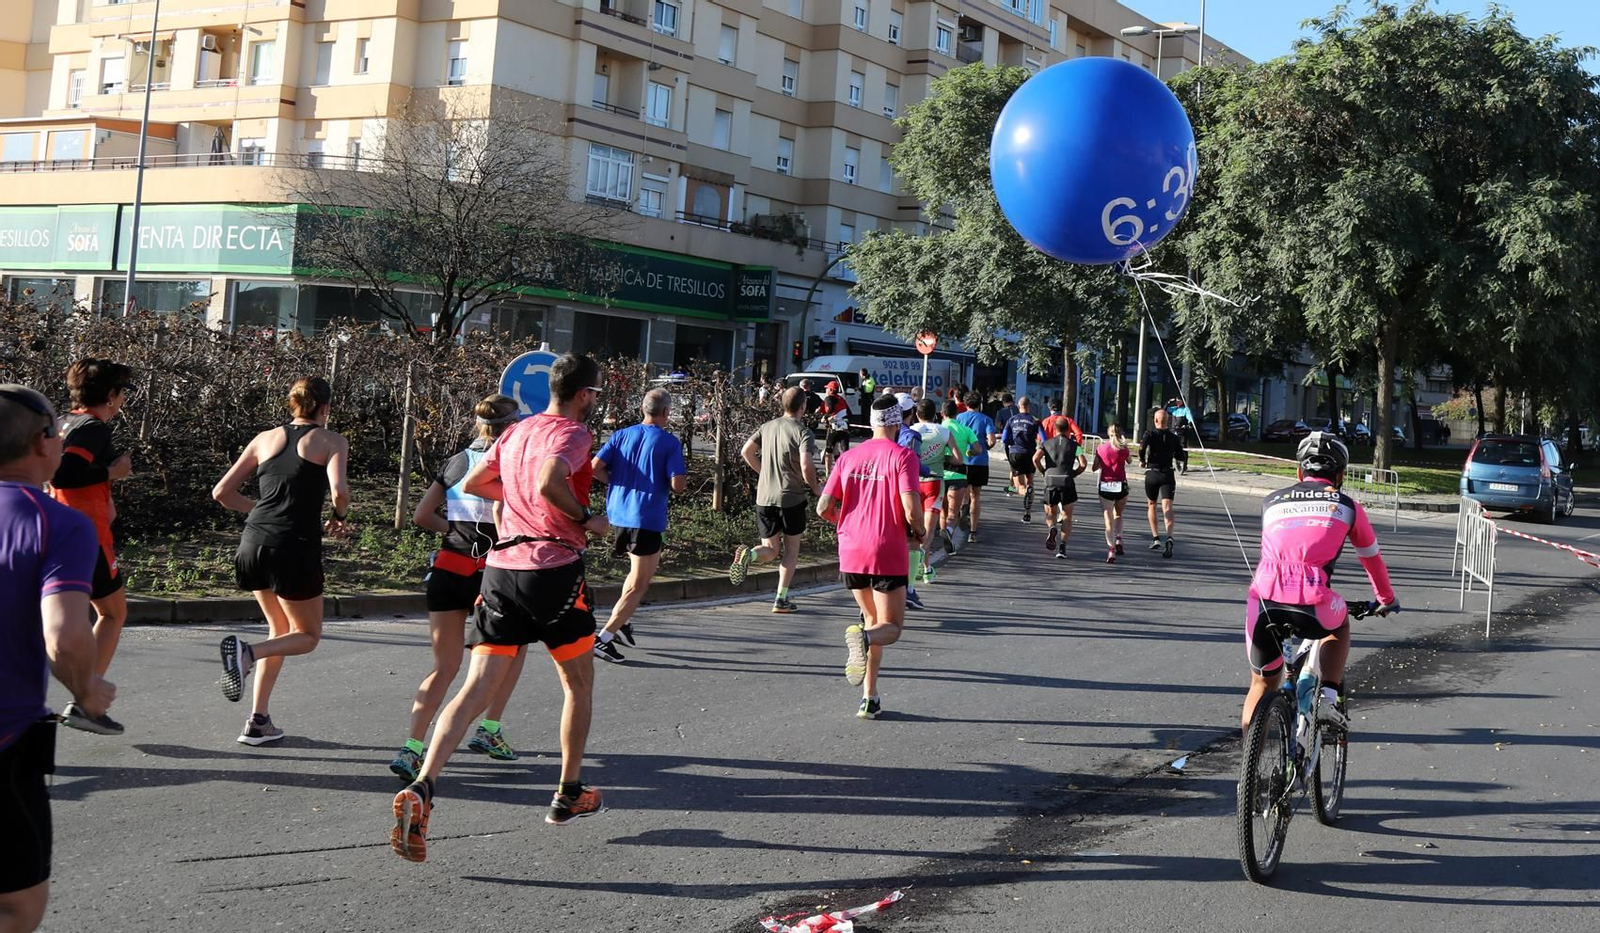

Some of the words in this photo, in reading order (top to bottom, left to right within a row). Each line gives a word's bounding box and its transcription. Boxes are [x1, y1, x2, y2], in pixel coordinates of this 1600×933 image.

[68, 234, 98, 252] SOFA
[192, 225, 283, 250] DIRECTA
[646, 272, 663, 290] DE
[667, 275, 725, 299] TRESILLOS
[740, 285, 766, 297] SOFA
[882, 360, 898, 370] 902
[900, 361, 910, 370] 88
[911, 361, 920, 370] 99
